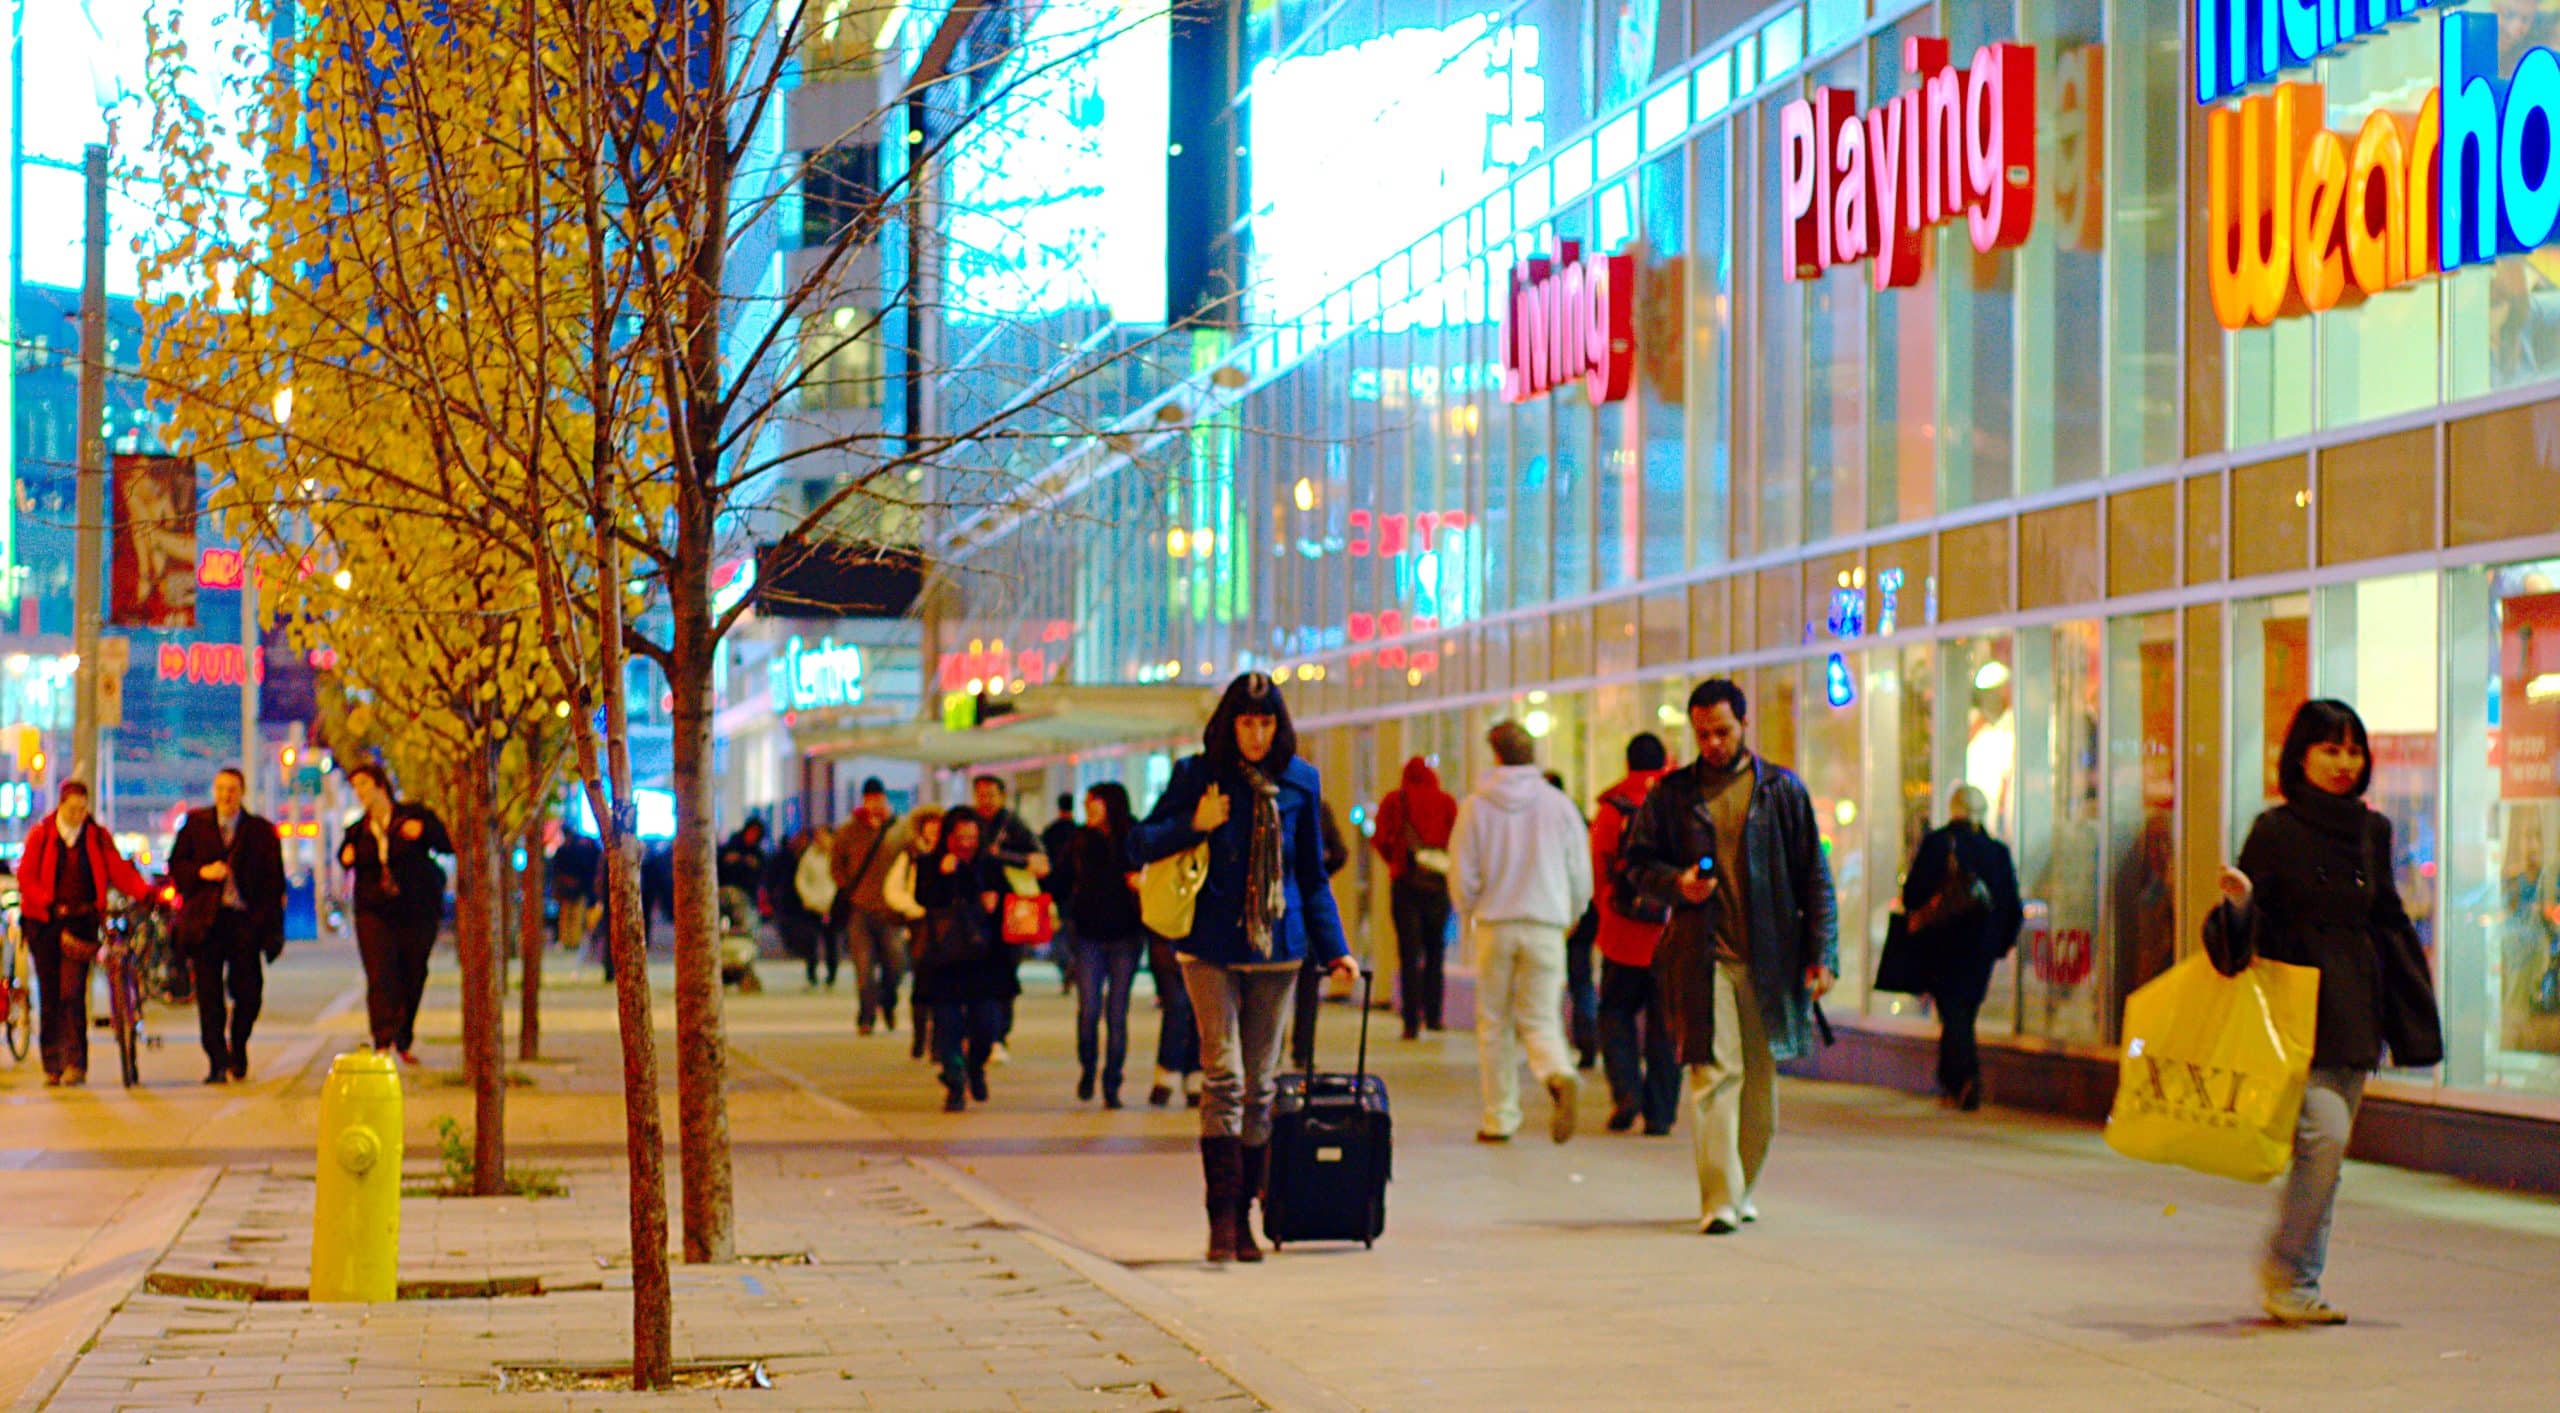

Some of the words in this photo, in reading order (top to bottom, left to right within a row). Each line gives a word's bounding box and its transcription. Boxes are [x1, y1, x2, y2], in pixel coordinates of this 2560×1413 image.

[1780, 36, 2006, 292] Playing
[1500, 234, 1611, 405] Living
[2132, 1056, 2247, 1113] XXI
